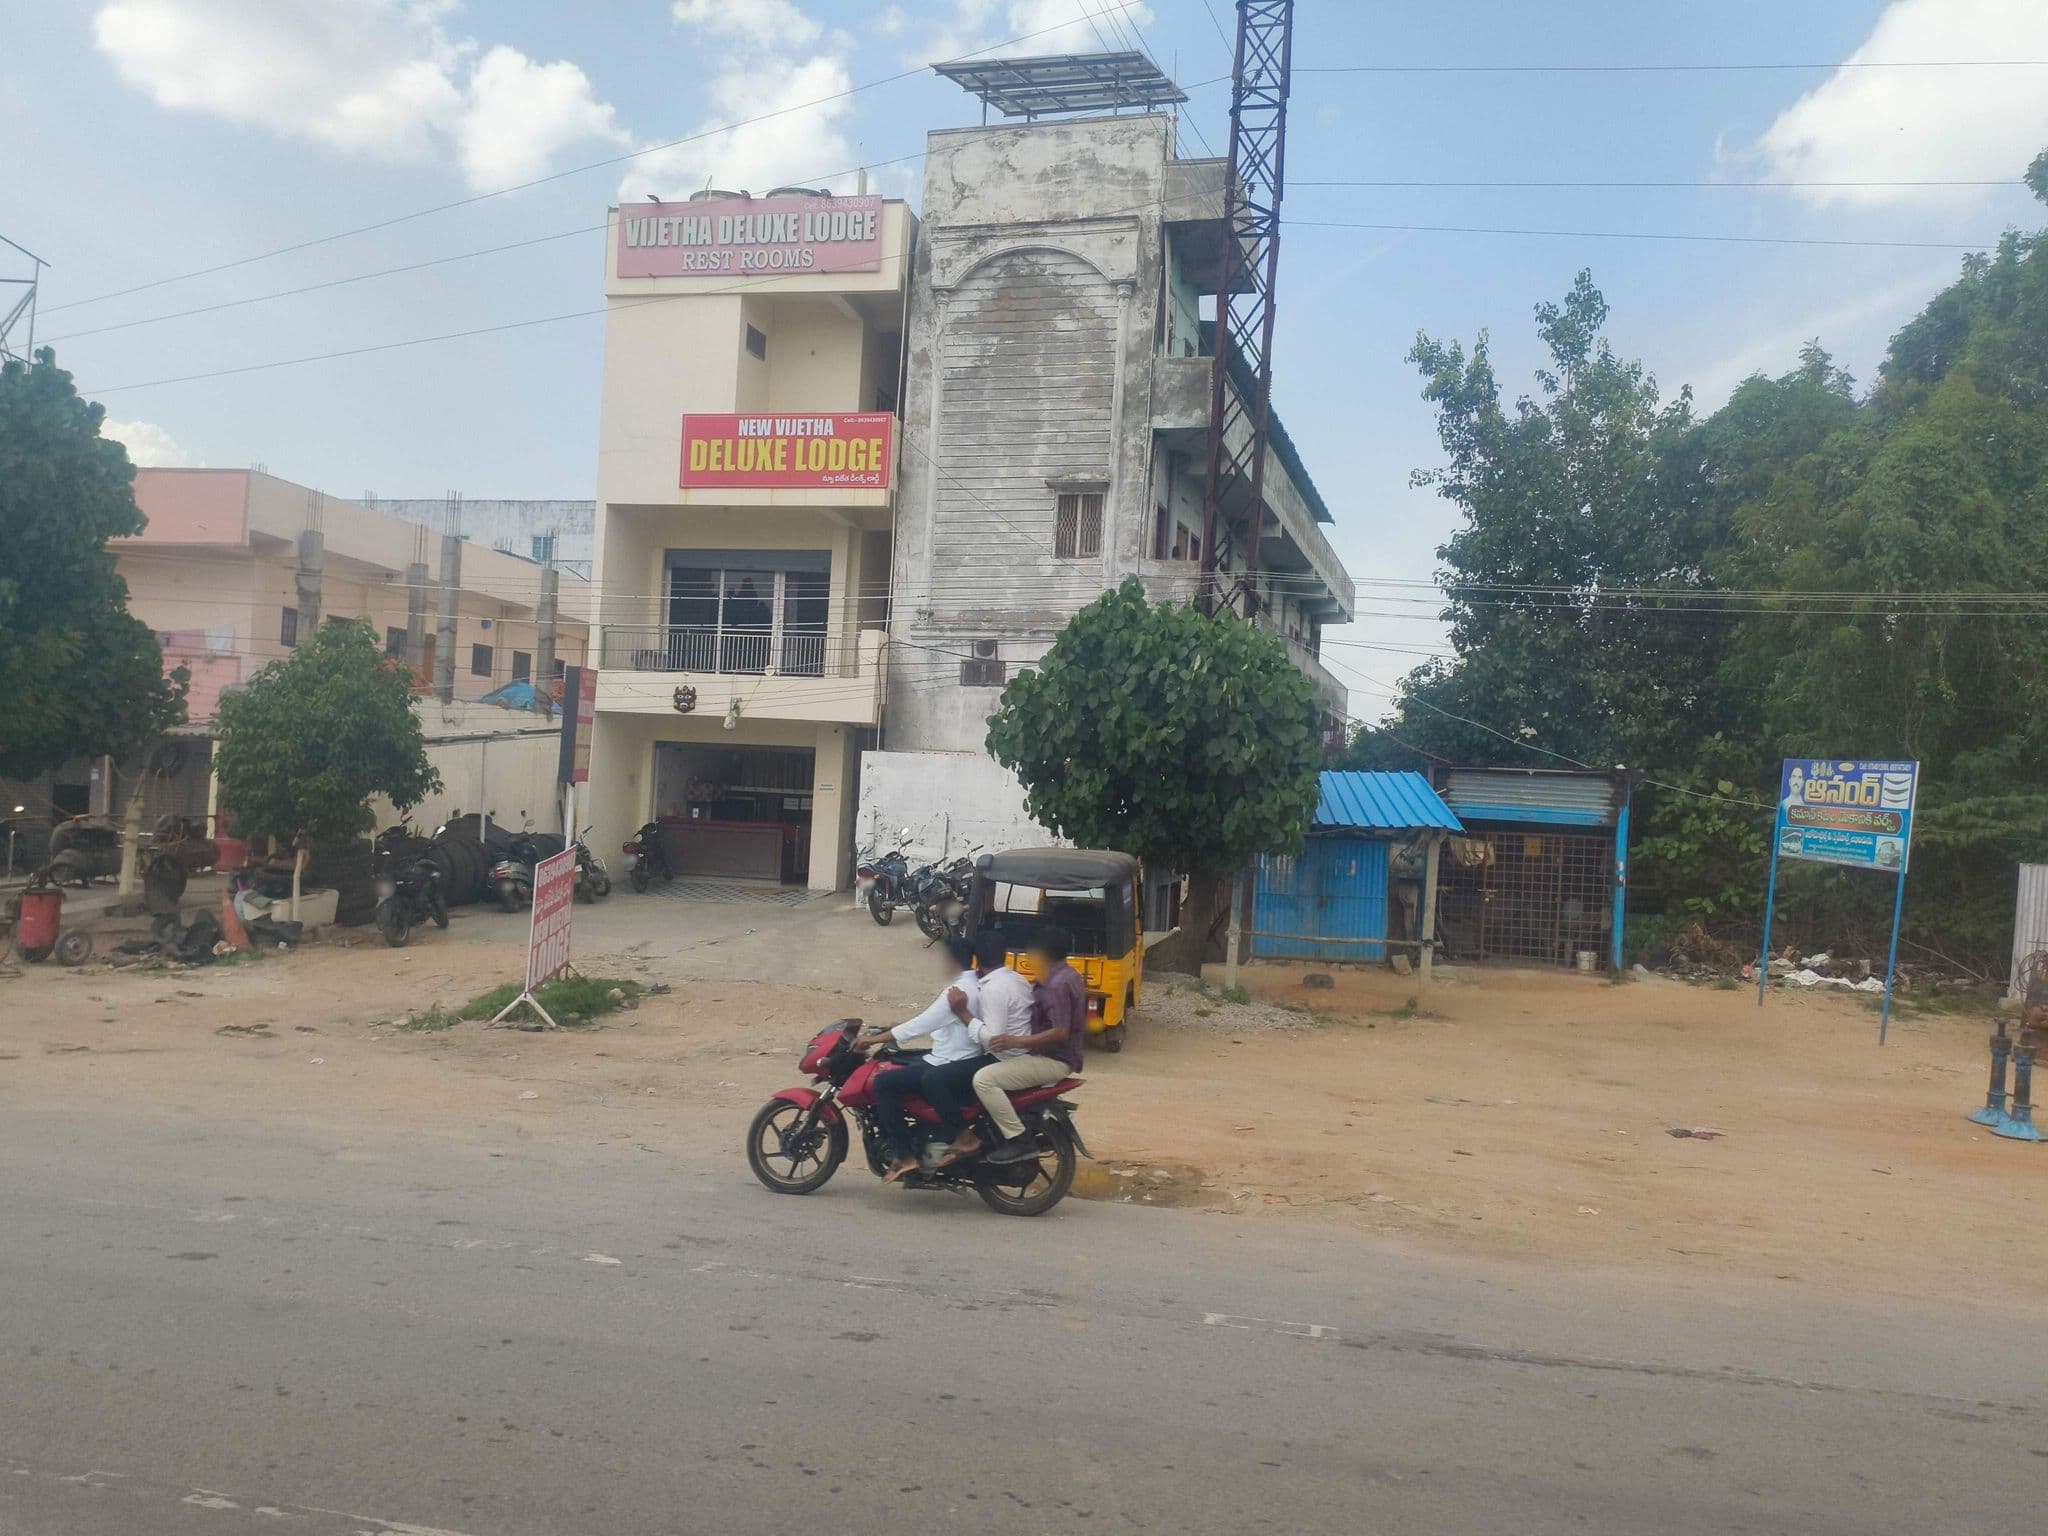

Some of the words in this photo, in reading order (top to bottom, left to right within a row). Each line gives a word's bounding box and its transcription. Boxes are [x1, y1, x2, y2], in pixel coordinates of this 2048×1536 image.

[625, 215, 712, 247] VIJETHA
[718, 213, 799, 244] DELUXE
[804, 210, 876, 242] LODGE
[681, 250, 734, 271] REST
[739, 248, 814, 269] ROOMS
[738, 418, 772, 436] NEW
[775, 418, 834, 436] VIJETHA
[689, 438, 788, 472] DELUXE
[794, 437, 883, 472] LODGE
[1805, 773, 1882, 806] ఆనంద్
[528, 925, 571, 989] LODGE
